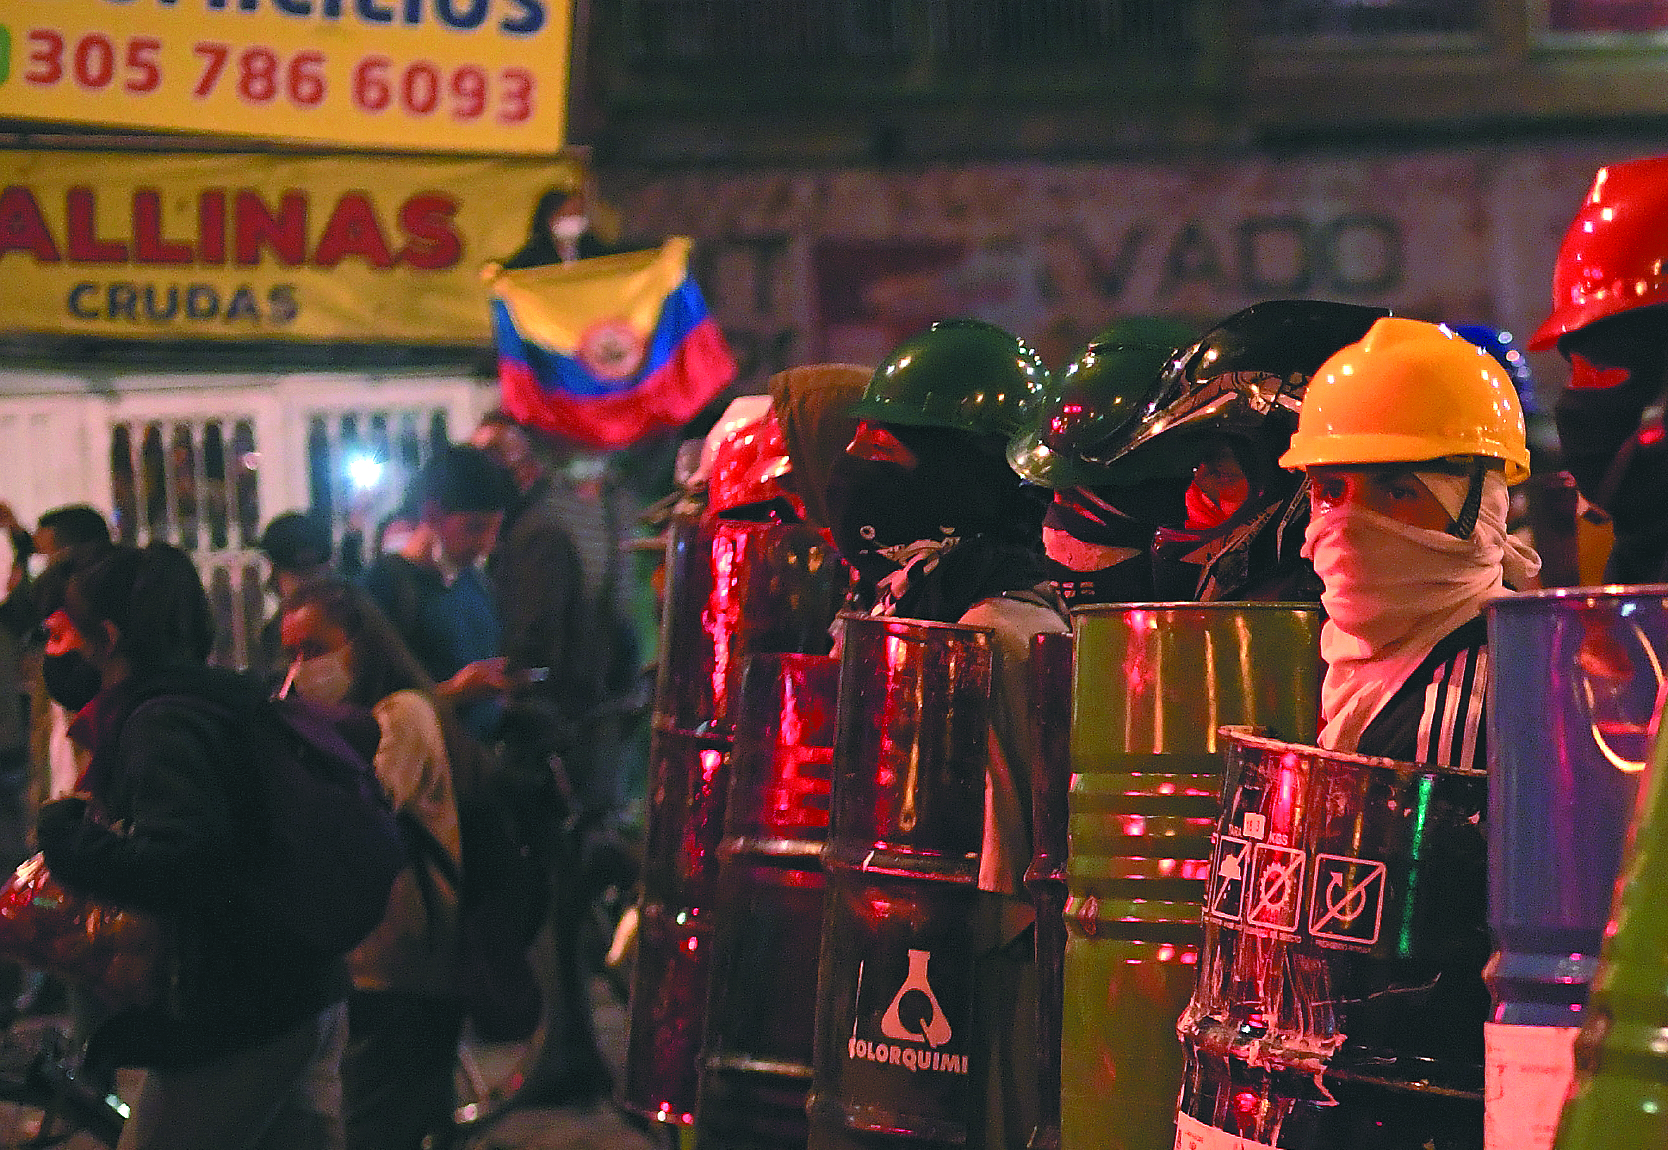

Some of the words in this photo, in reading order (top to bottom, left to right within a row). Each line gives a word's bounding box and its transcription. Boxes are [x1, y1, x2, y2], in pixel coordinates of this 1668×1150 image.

[24, 28, 163, 95] 305
[192, 42, 328, 109] 786
[351, 55, 535, 123] 6093
[0, 184, 463, 270] ALLINAS
[67, 282, 299, 323] CRUDAS
